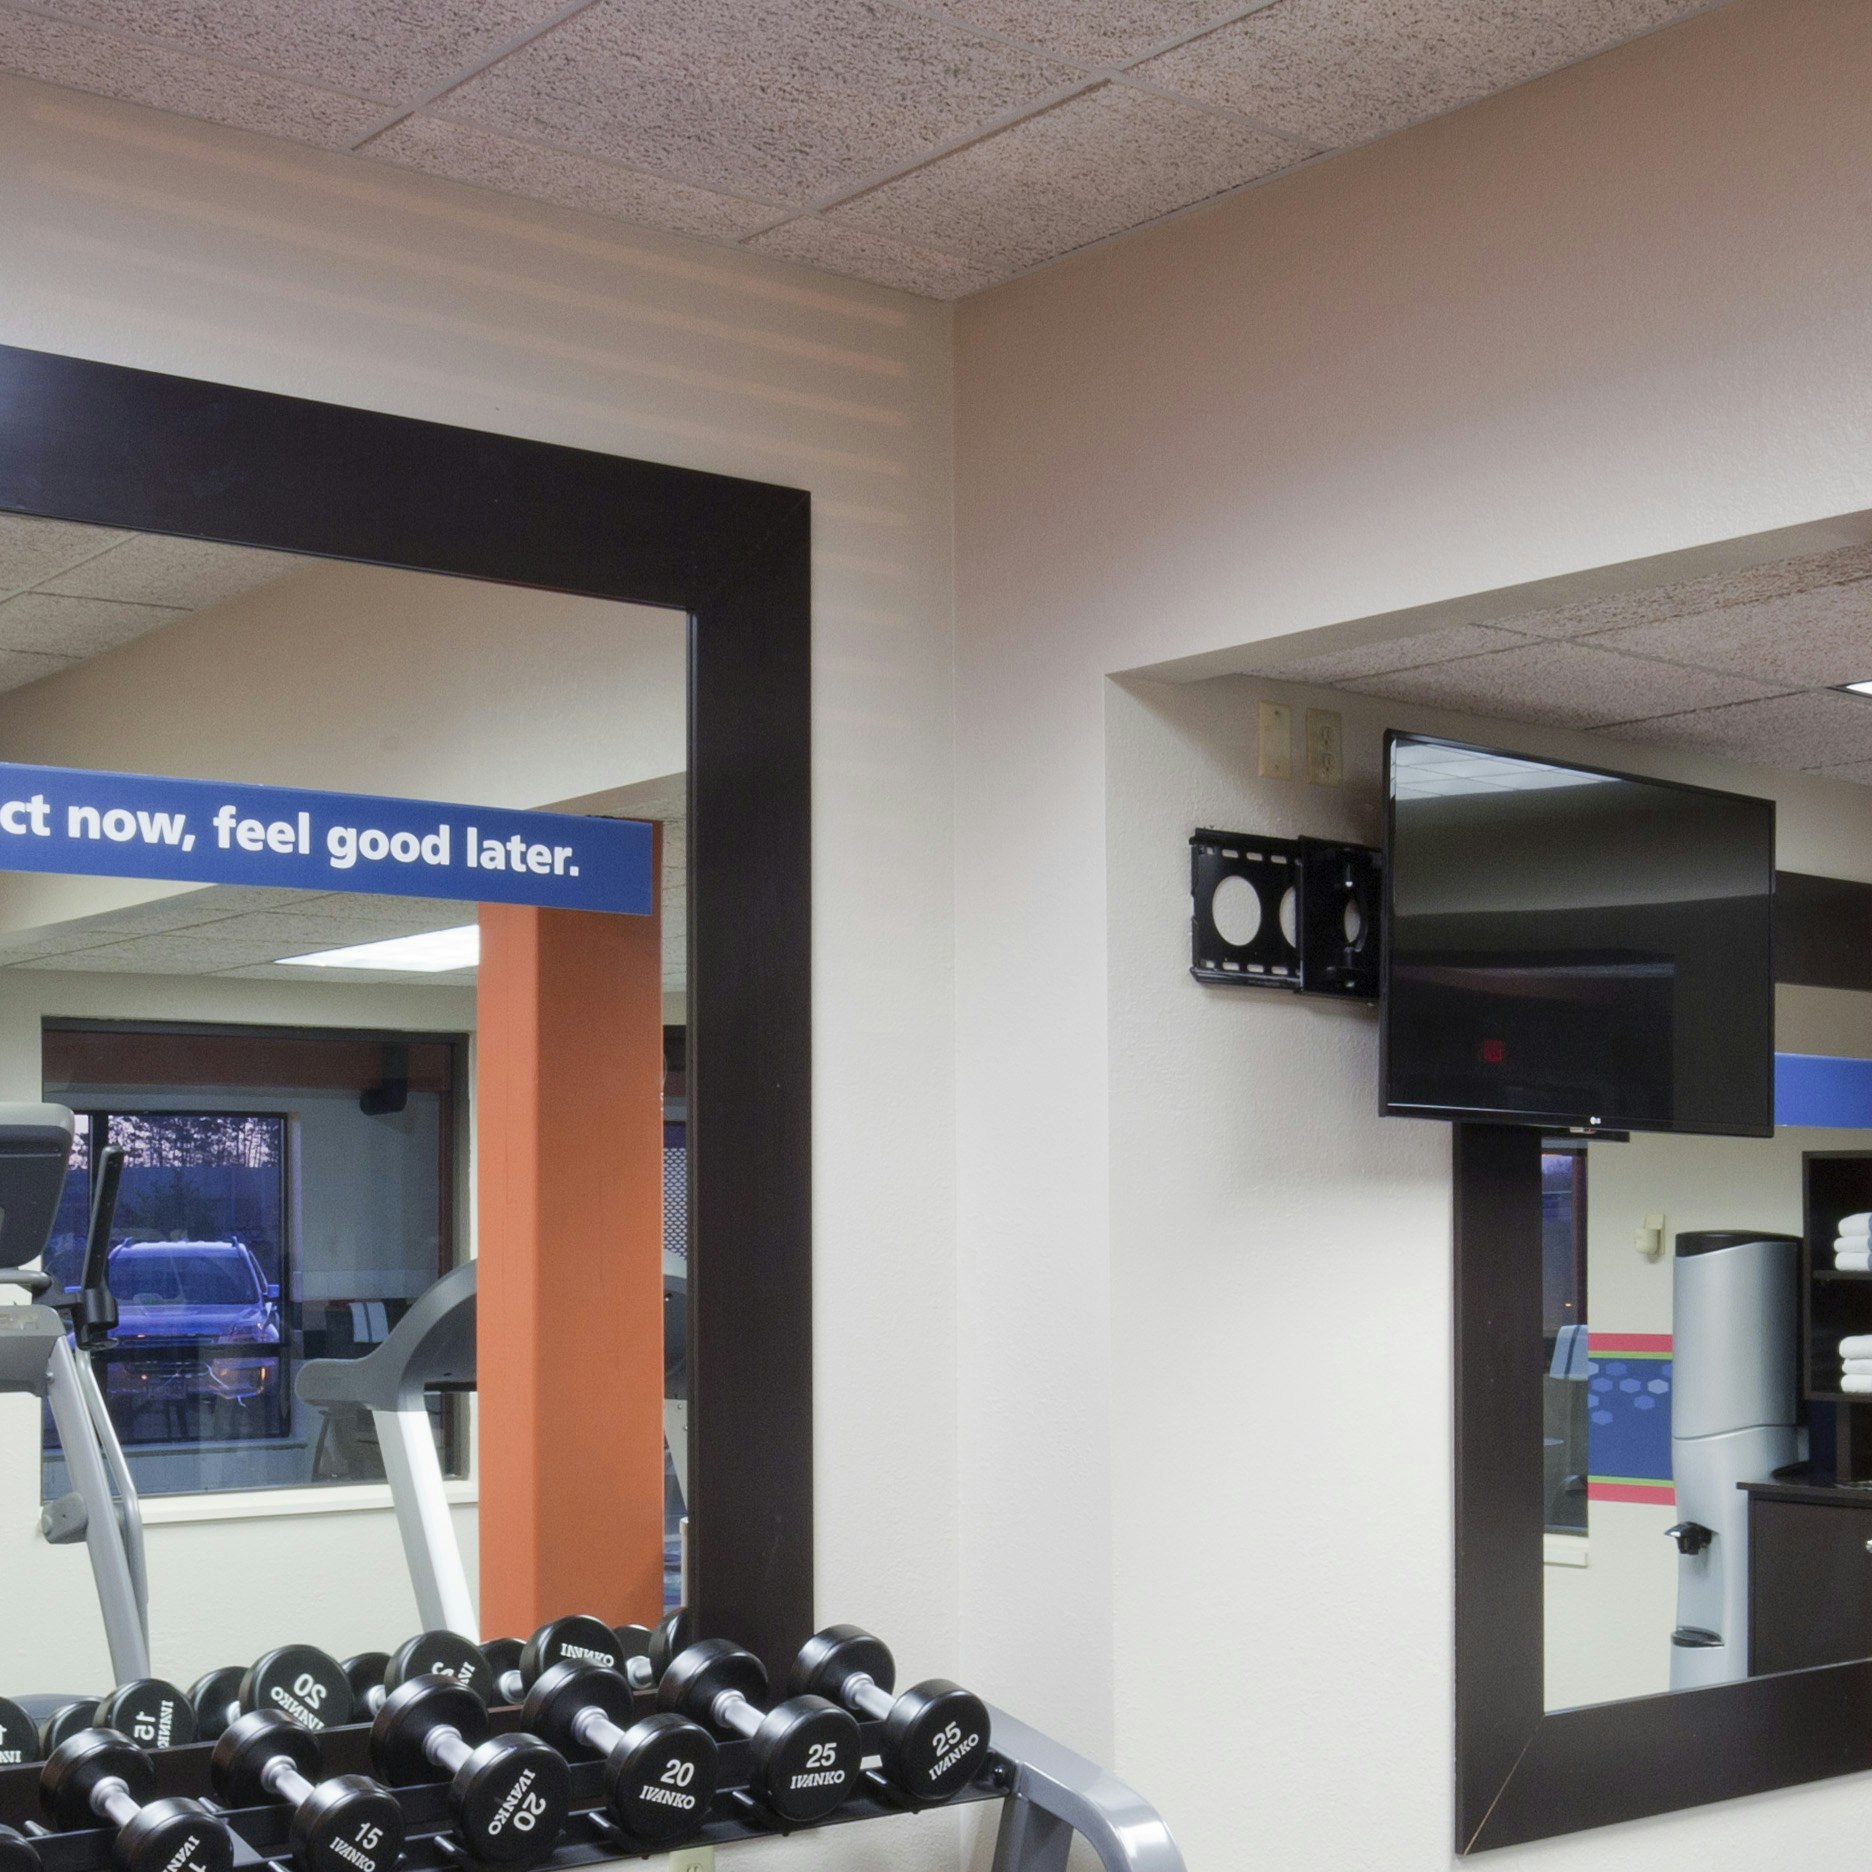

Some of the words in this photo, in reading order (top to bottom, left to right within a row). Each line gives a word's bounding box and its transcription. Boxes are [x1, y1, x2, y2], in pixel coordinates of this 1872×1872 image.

[68, 805, 196, 853] now,
[213, 805, 310, 855] feel
[327, 825, 451, 870] good
[466, 827, 581, 877] later.
[806, 1742, 837, 1768] 25
[932, 1721, 961, 1757] 25
[660, 1759, 694, 1787] 20
[928, 1733, 980, 1781] IVANKO
[790, 1770, 845, 1790] IVANKO
[488, 1768, 536, 1836] IVANKO
[513, 1792, 546, 1833] 20
[639, 1785, 695, 1810] IVANKO
[354, 1822, 383, 1850] 15
